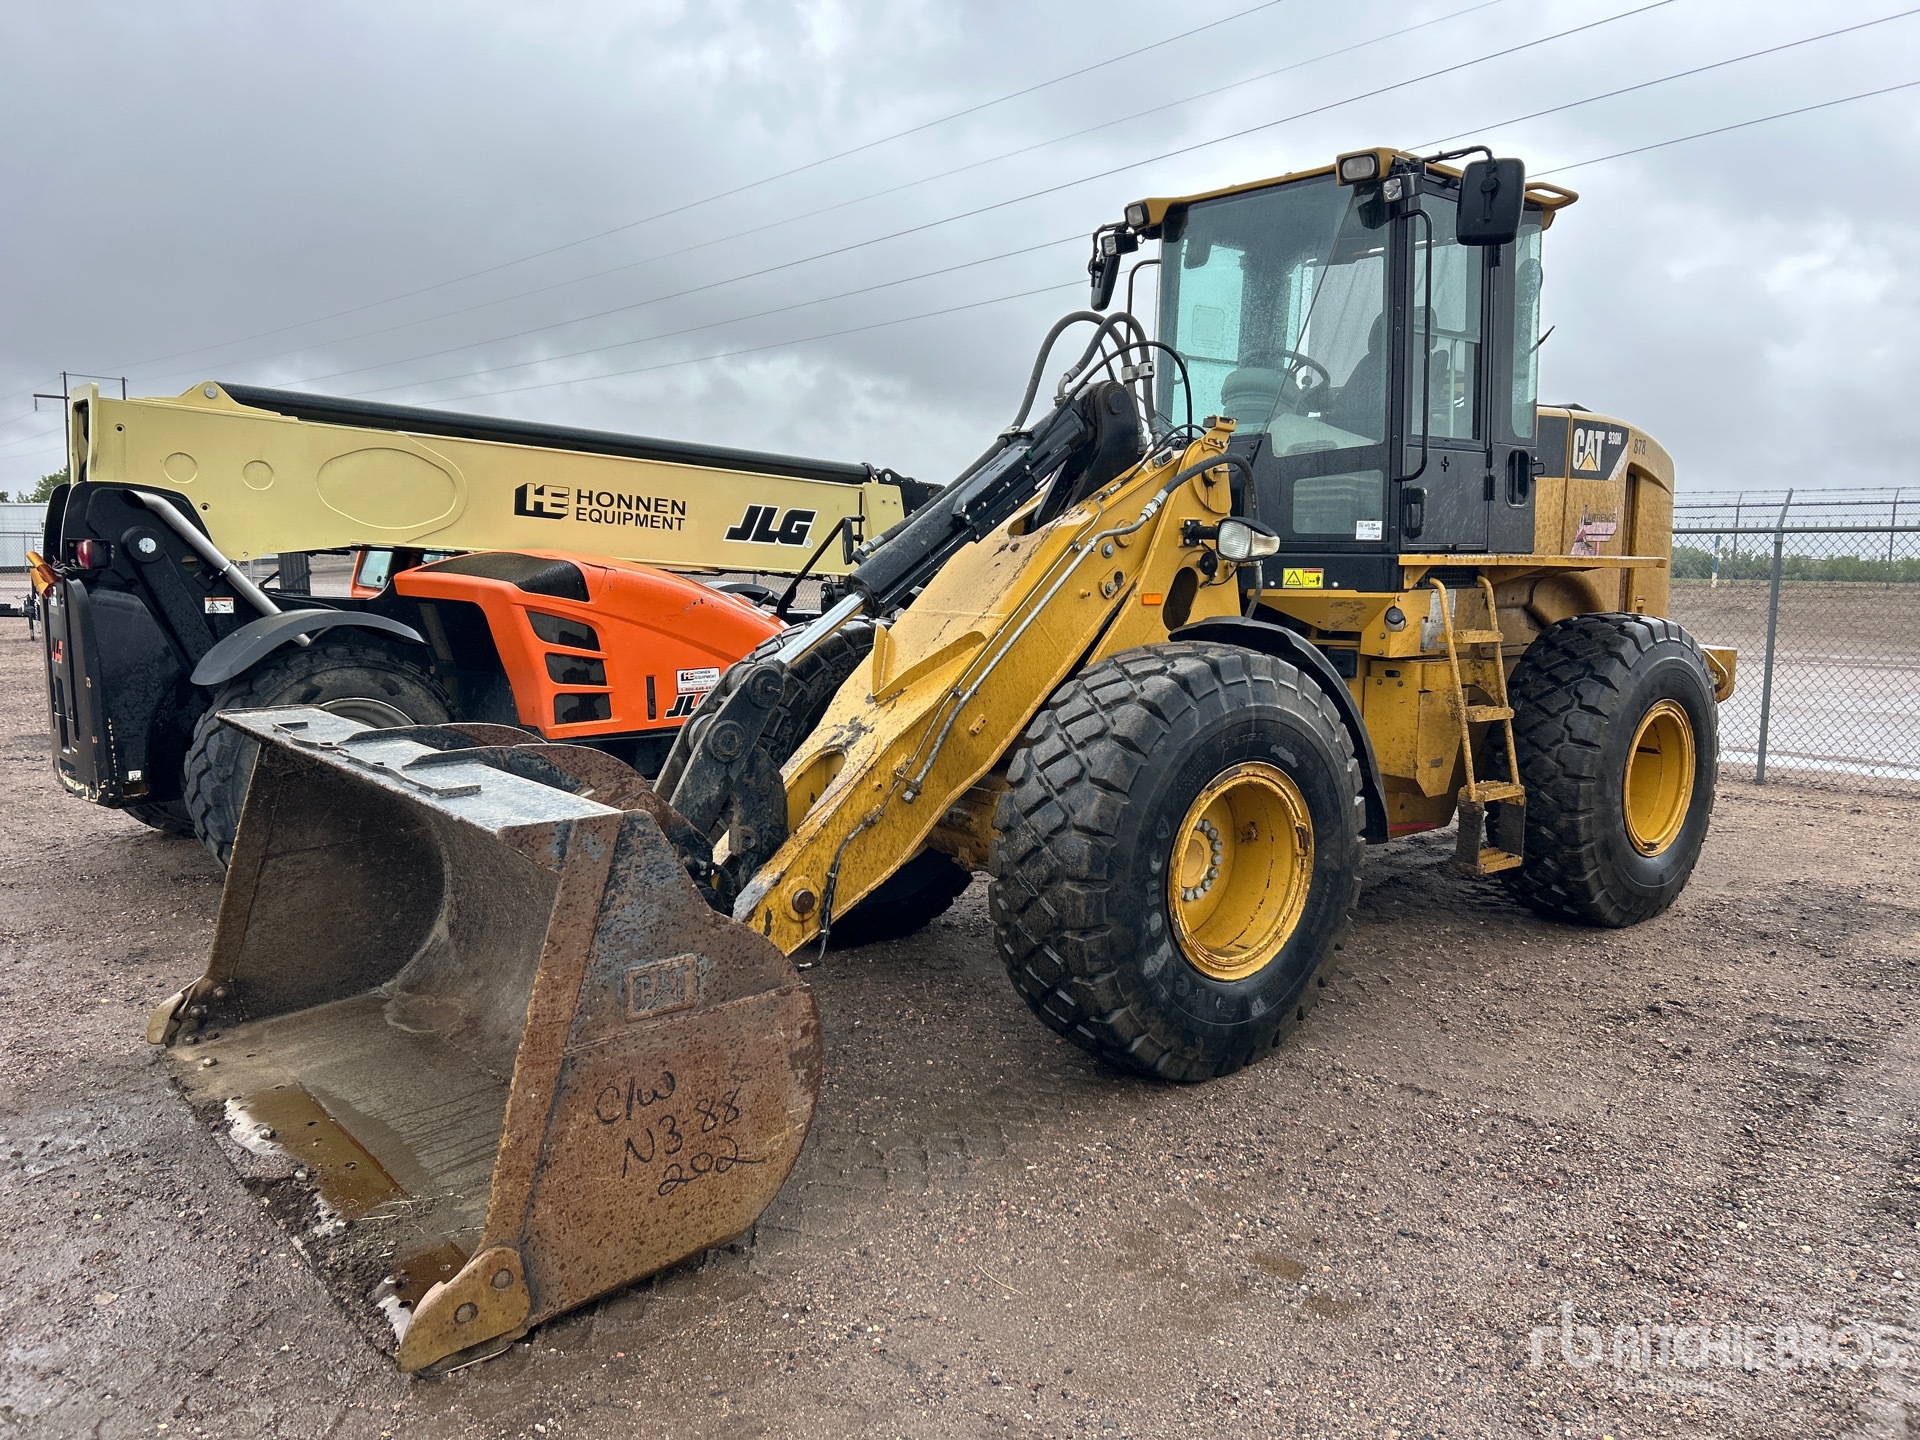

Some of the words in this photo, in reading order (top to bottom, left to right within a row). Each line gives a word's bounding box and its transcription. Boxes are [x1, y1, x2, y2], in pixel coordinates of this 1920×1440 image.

[1573, 428, 1605, 471] CAT
[1634, 438, 1647, 455] 878
[575, 507, 686, 531] EQUIPMENT
[576, 489, 686, 516] HONNEN
[723, 503, 818, 547] JLG
[632, 964, 689, 1013] CAT
[658, 1135, 767, 1196] 202
